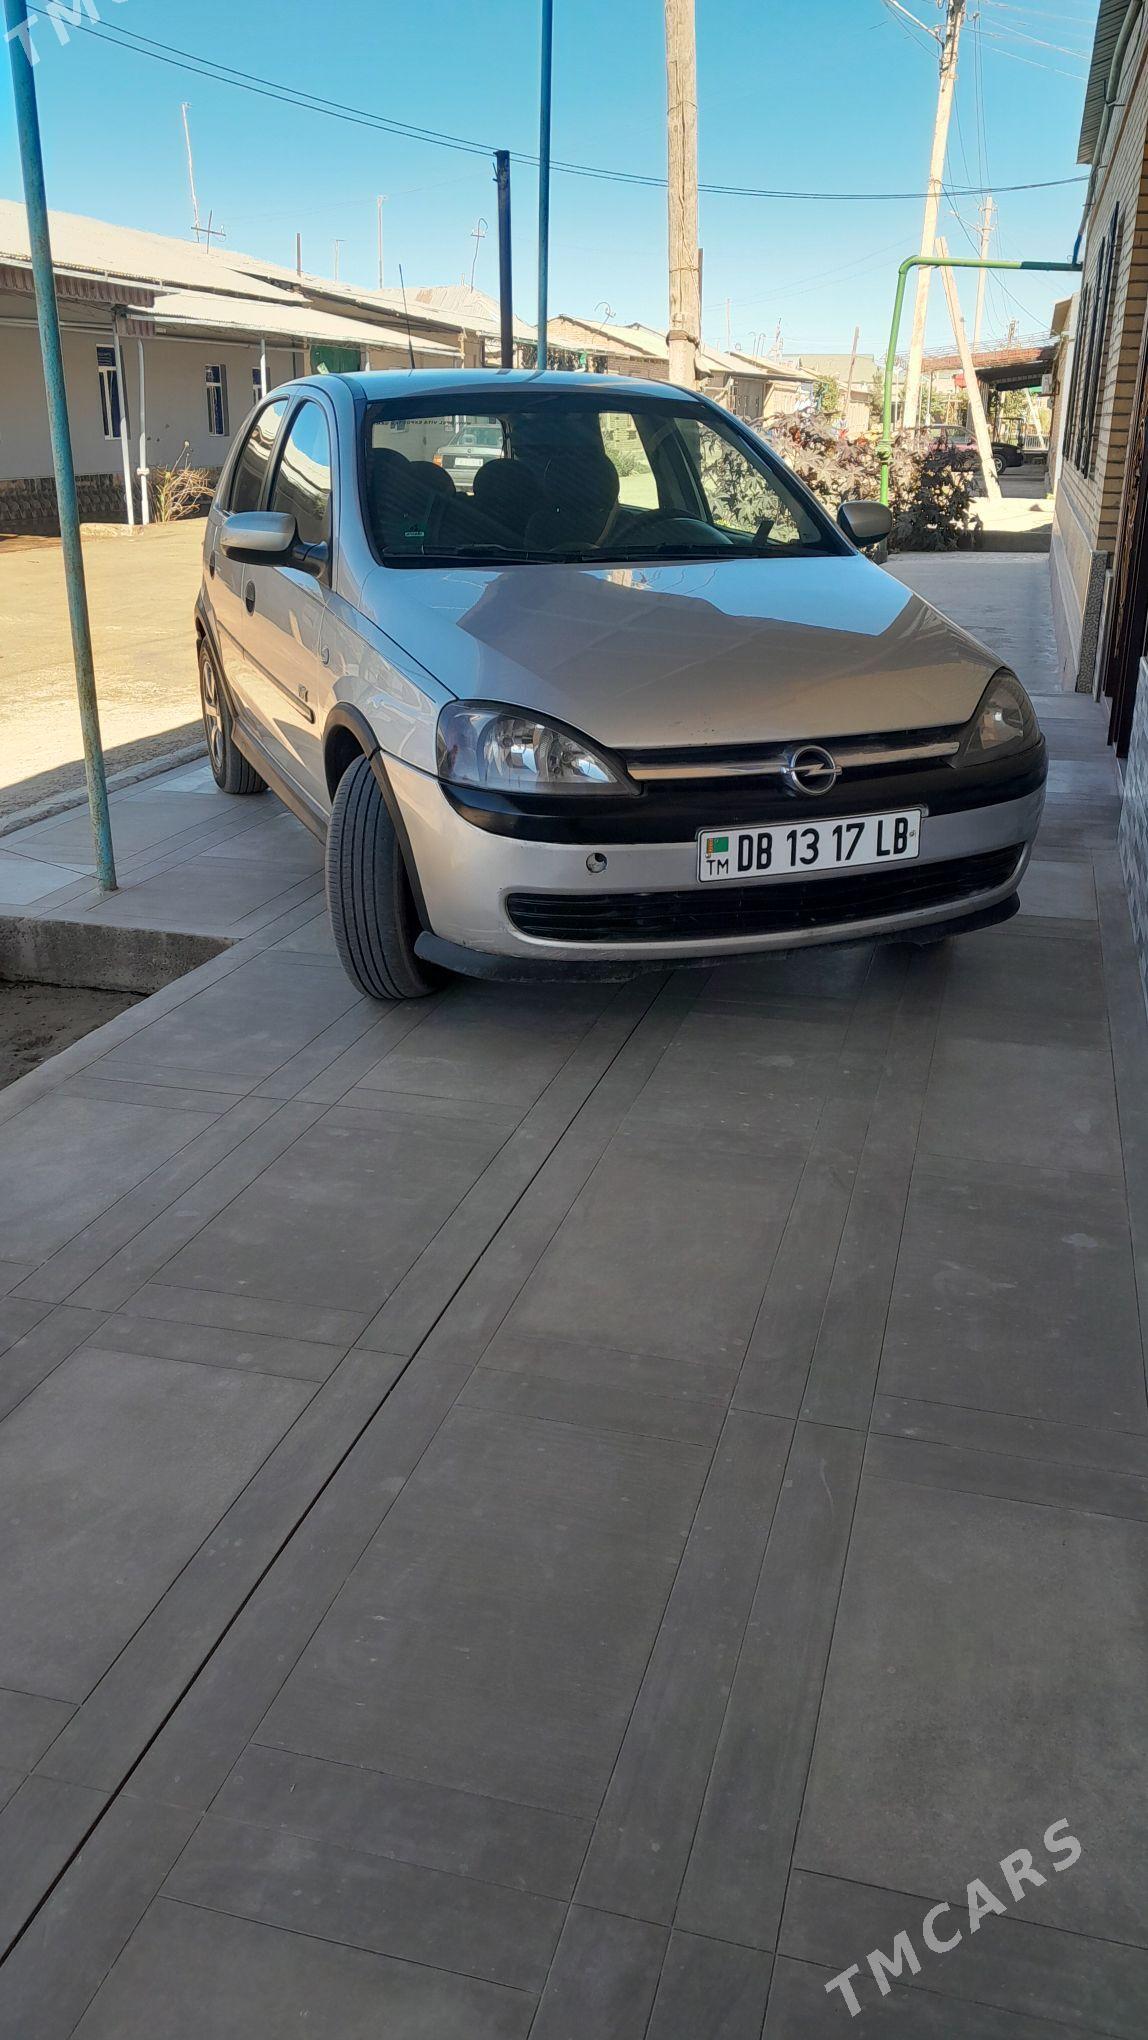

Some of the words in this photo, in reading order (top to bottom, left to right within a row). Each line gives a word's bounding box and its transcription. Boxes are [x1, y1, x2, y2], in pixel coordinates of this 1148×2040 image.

[738, 832, 773, 872] DB
[786, 828, 820, 866] 13
[832, 822, 865, 862] 17
[876, 817, 909, 857] LB
[706, 858, 729, 875] TM
